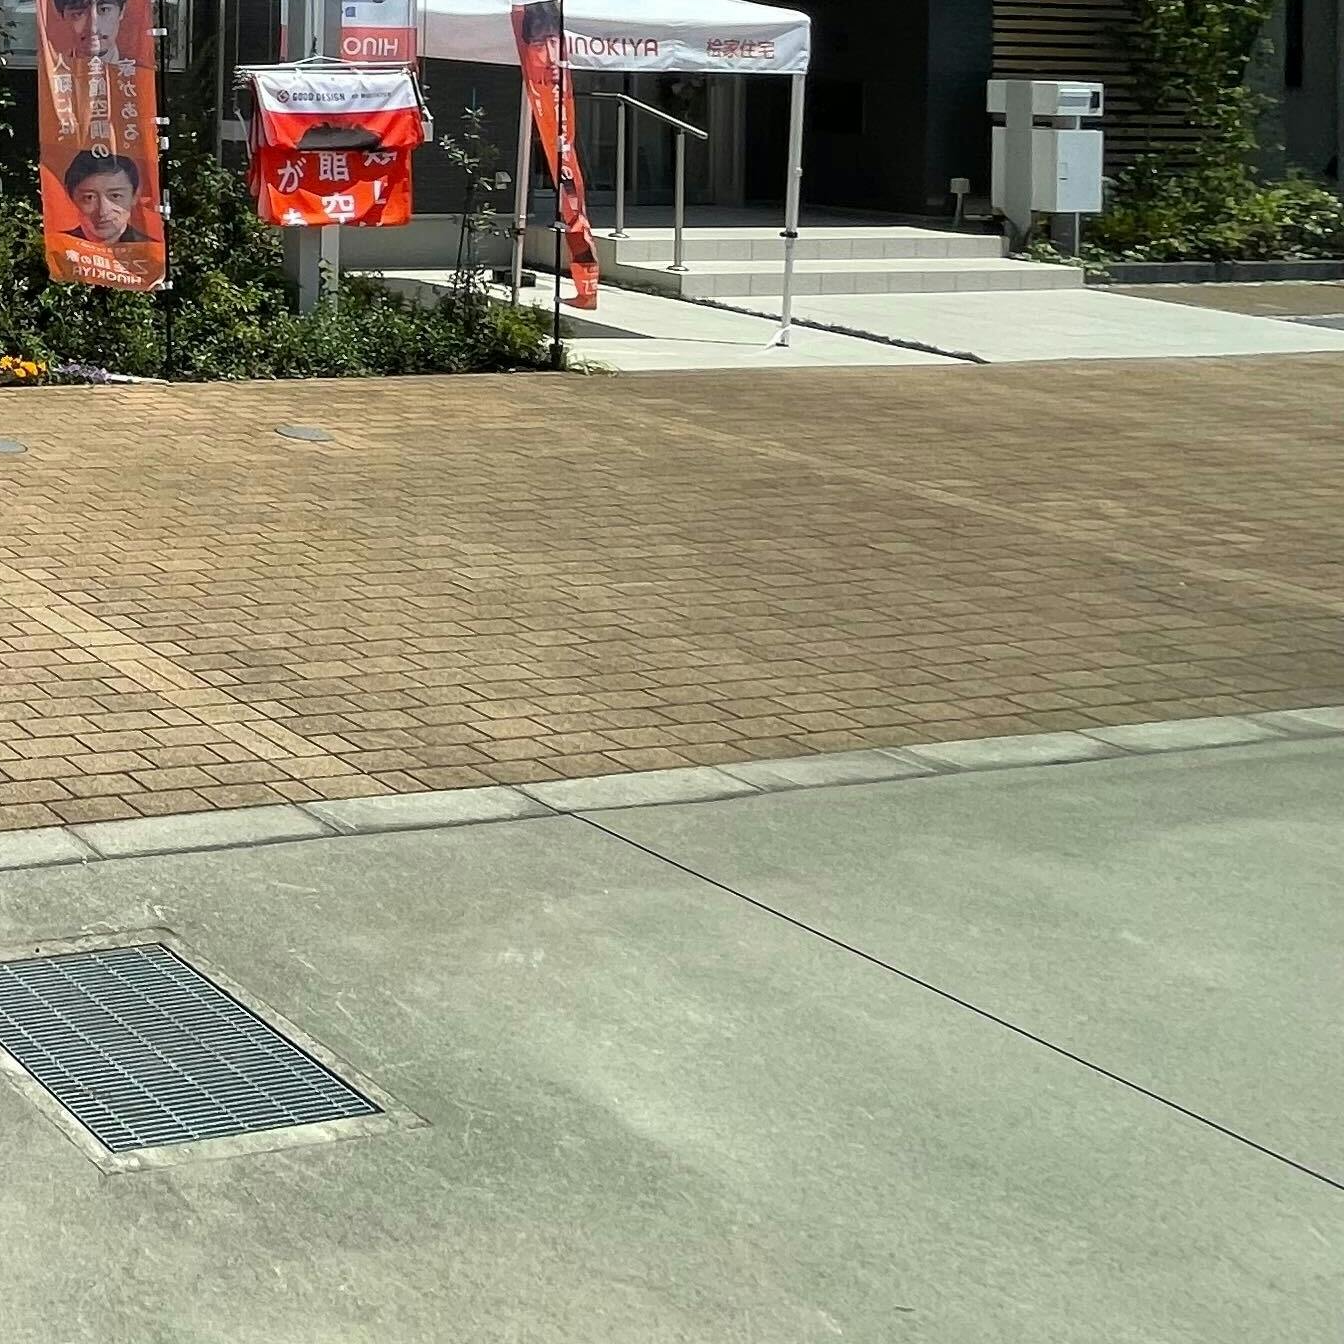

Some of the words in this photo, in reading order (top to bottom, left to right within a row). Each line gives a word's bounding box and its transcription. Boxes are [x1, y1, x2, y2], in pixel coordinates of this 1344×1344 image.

[568, 36, 659, 57] INOKIYA
[292, 92, 314, 102] GOOD
[316, 92, 346, 102] DESIGN
